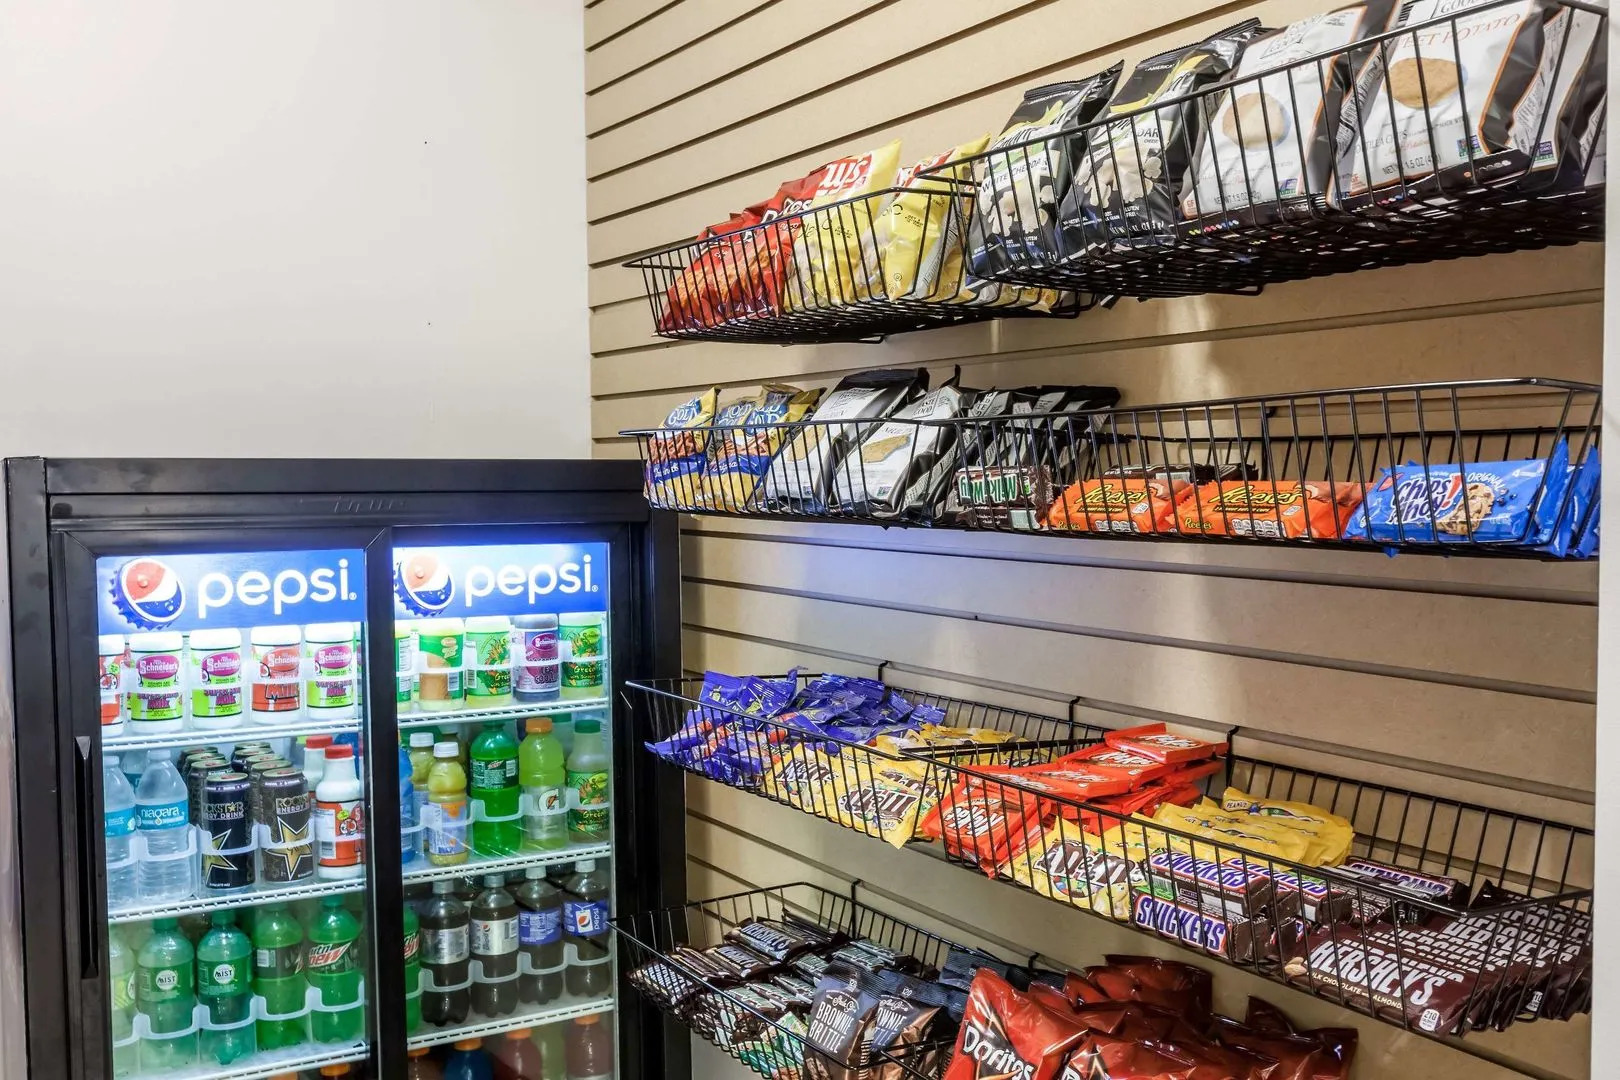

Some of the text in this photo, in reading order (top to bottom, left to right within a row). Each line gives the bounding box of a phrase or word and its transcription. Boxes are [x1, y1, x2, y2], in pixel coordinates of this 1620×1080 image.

[198, 558, 348, 619] pepsi
[465, 554, 592, 607] pepsi
[141, 806, 179, 825] niagara
[1225, 800, 1249, 809] PEANUT
[1136, 897, 1225, 952] SNICKERS
[213, 969, 233, 979] MIST
[1310, 940, 1446, 1006] HERSHEY'S
[816, 1001, 855, 1036] BROWNIE
[1423, 1010, 1438, 1021] 210
[808, 1019, 845, 1054] BRITTLE
[963, 1025, 1035, 1080] Doritos
